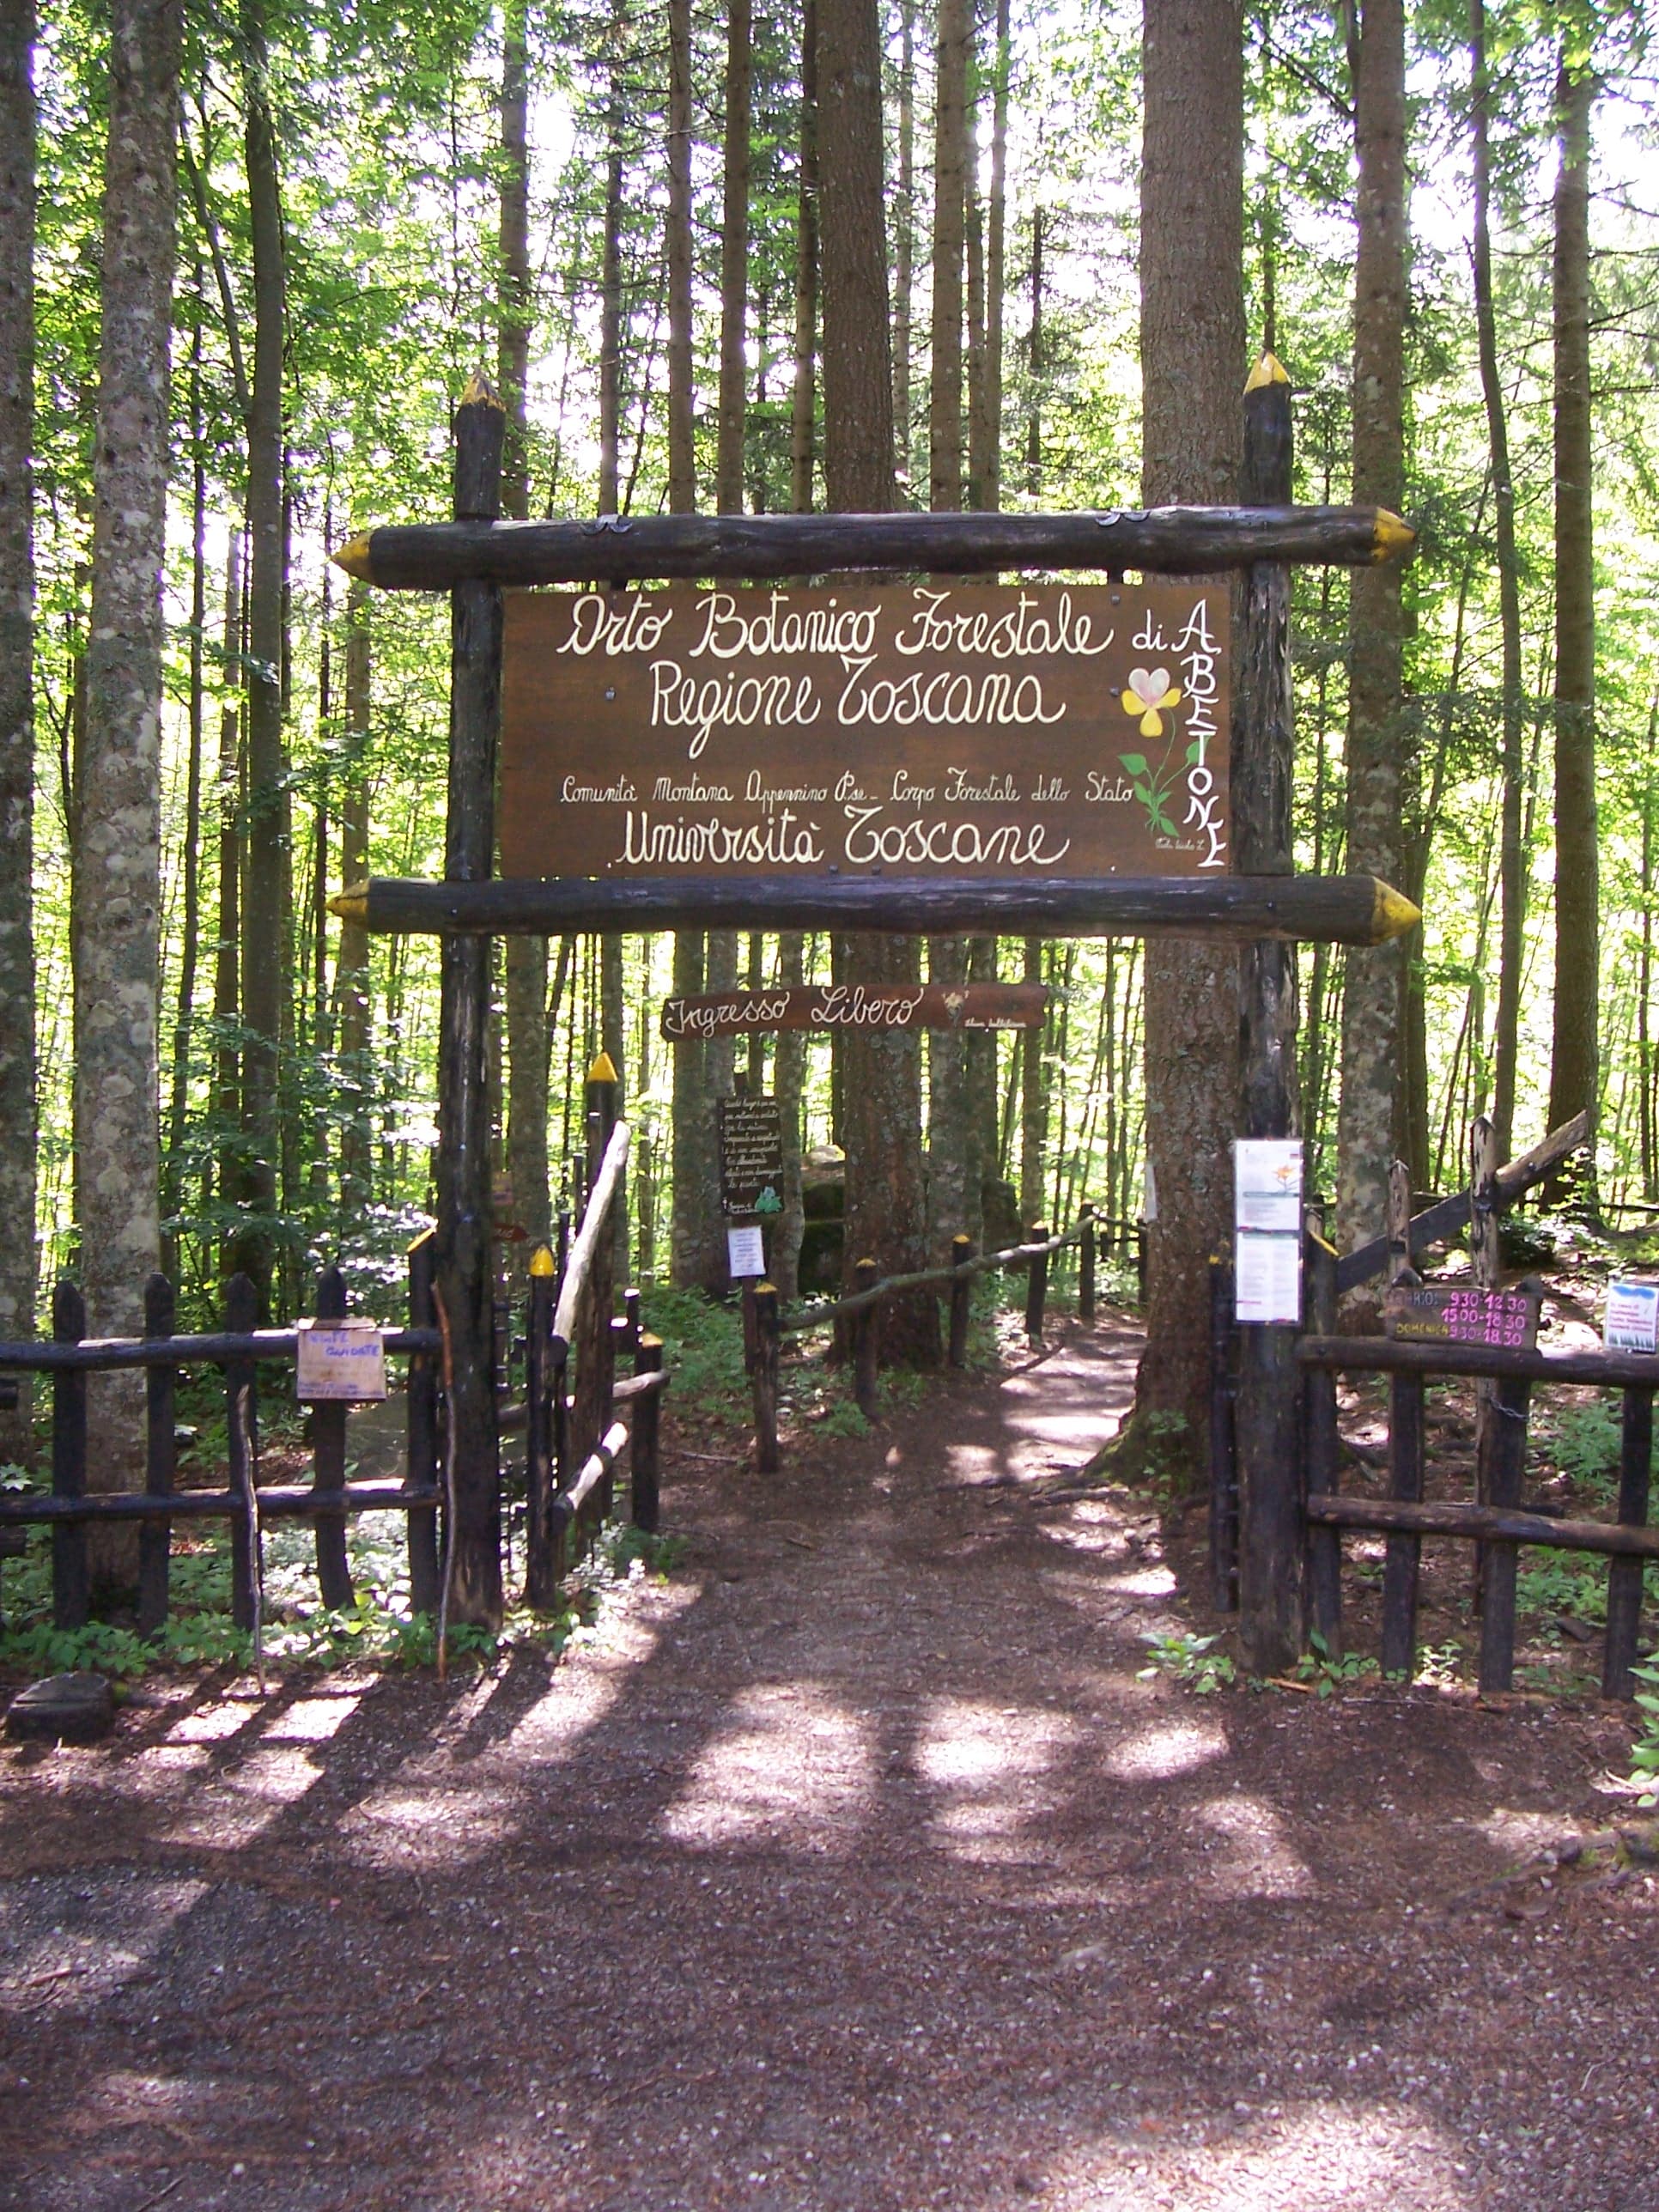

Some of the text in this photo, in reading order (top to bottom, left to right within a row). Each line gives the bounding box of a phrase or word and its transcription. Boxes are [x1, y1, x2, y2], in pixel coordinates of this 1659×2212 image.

[556, 588, 1168, 659] Orto Botanico Forestale di
[650, 653, 1066, 759] Regione Toscana
[1170, 599, 1226, 867] ABETONE
[560, 774, 638, 803] Comunità
[652, 772, 734, 803] Montana
[744, 769, 828, 815] Appennino
[890, 769, 937, 811] Corpo
[945, 767, 1022, 803] Forestale
[1031, 774, 1071, 802] dello
[1085, 770, 1134, 803] Stato
[616, 805, 1070, 864] Università Toscane
[665, 986, 925, 1038] Ingresso Libero
